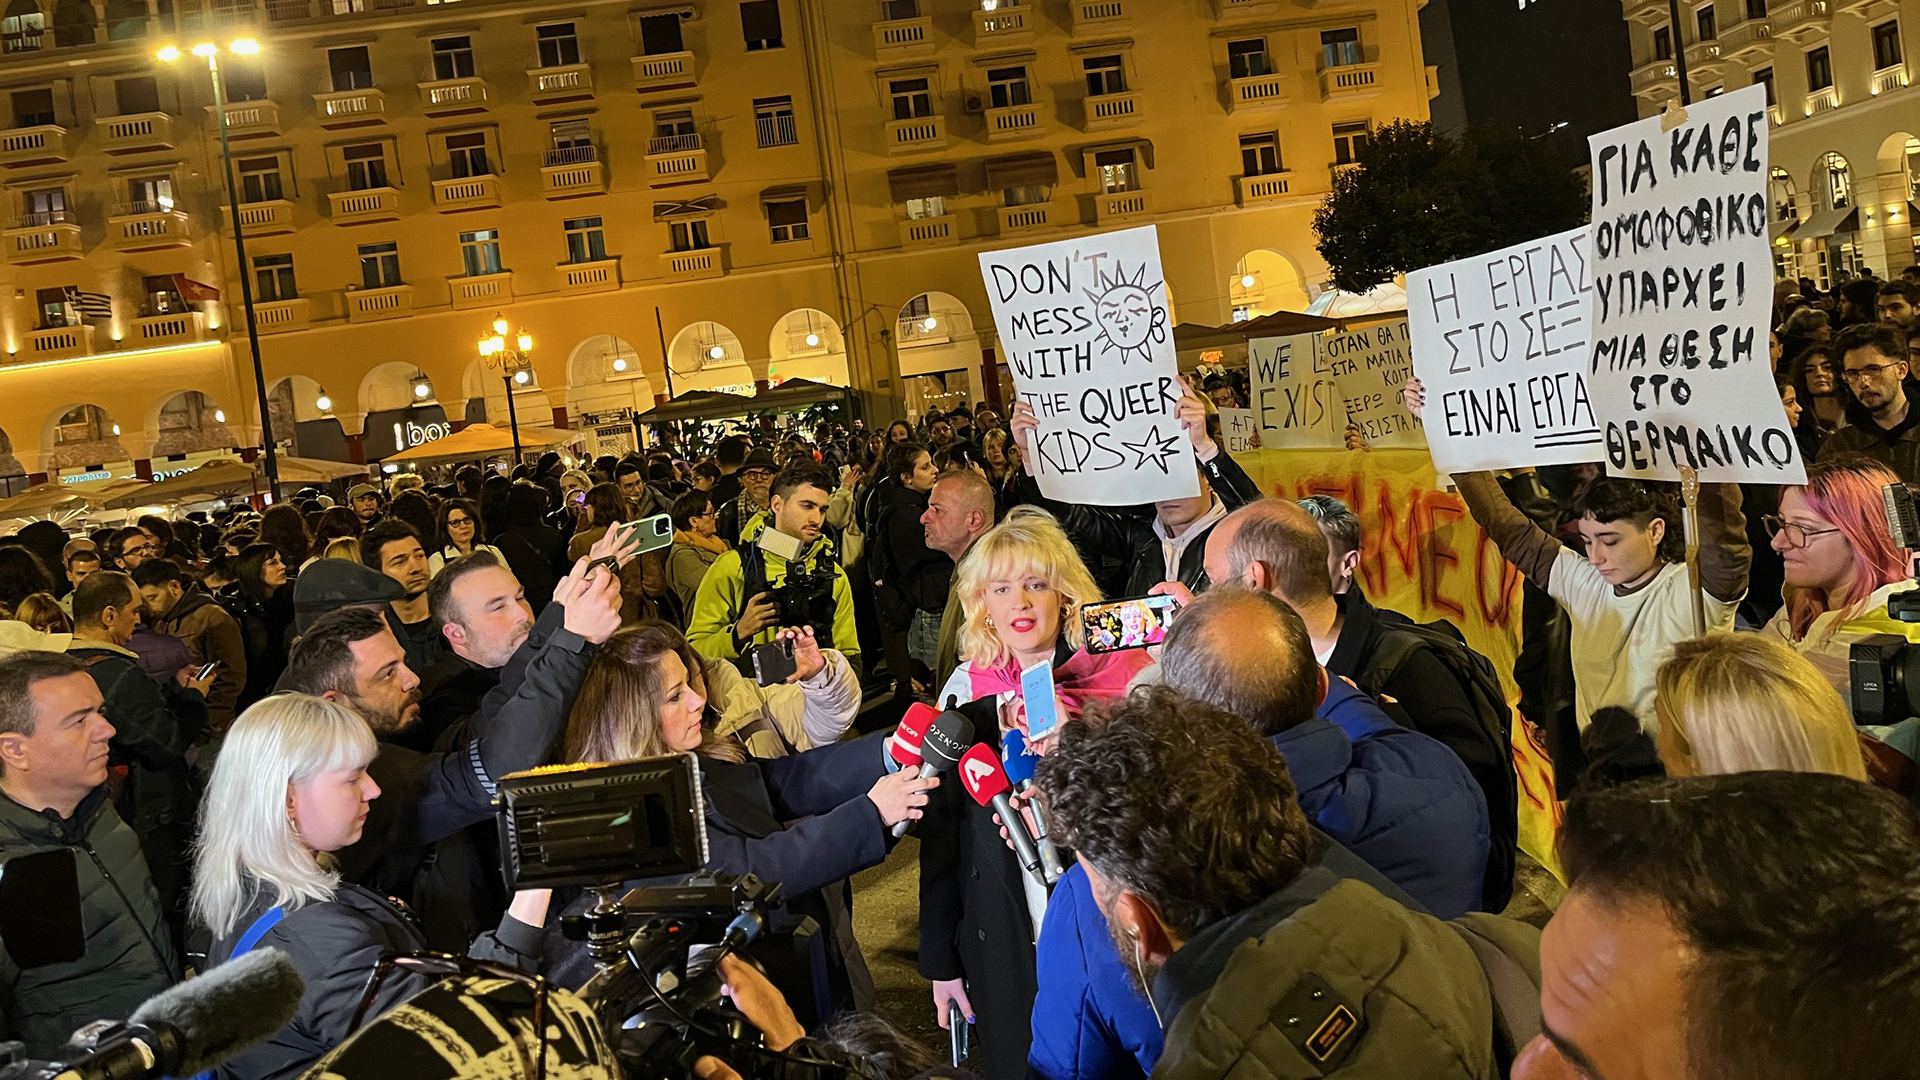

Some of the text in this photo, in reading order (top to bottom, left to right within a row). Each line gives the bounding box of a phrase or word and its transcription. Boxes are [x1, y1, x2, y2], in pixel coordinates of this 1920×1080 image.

[1599, 110, 1763, 207] ΓΙΑ ΚΑΘΕ
[991, 250, 1107, 303] DON'T
[1428, 233, 1592, 323] Η ΕΡΓΑΣ
[1596, 261, 1745, 325] ΥΠΑΡΧΕΙ
[1011, 306, 1092, 340] MESS
[1328, 332, 1370, 357] ΟΤΑΝ
[1378, 327, 1394, 345] ΘΑ
[1444, 299, 1586, 374] ΣΤΟ ΣΕΞ
[1013, 341, 1091, 379] WITH
[1254, 344, 1291, 383] WE
[1331, 359, 1358, 377] ΣΤΑ
[1366, 348, 1405, 370] ΜΑΤΙΑ
[1592, 324, 1754, 375] ΜΙΑ ΘΕΣΗ
[1382, 364, 1414, 386] ΚΟΙΤ
[1630, 374, 1692, 410] ΣΤΟ
[1021, 377, 1178, 428] THE QUEER
[1260, 380, 1335, 432] EXIST
[1443, 372, 1598, 436] ΕΙΝΑΙ ΕΡΓΑ
[1034, 428, 1125, 475] KIDS
[1606, 420, 1792, 470] ΘΕΡΜΑΙΚΟ
[930, 724, 952, 747] OPEN
